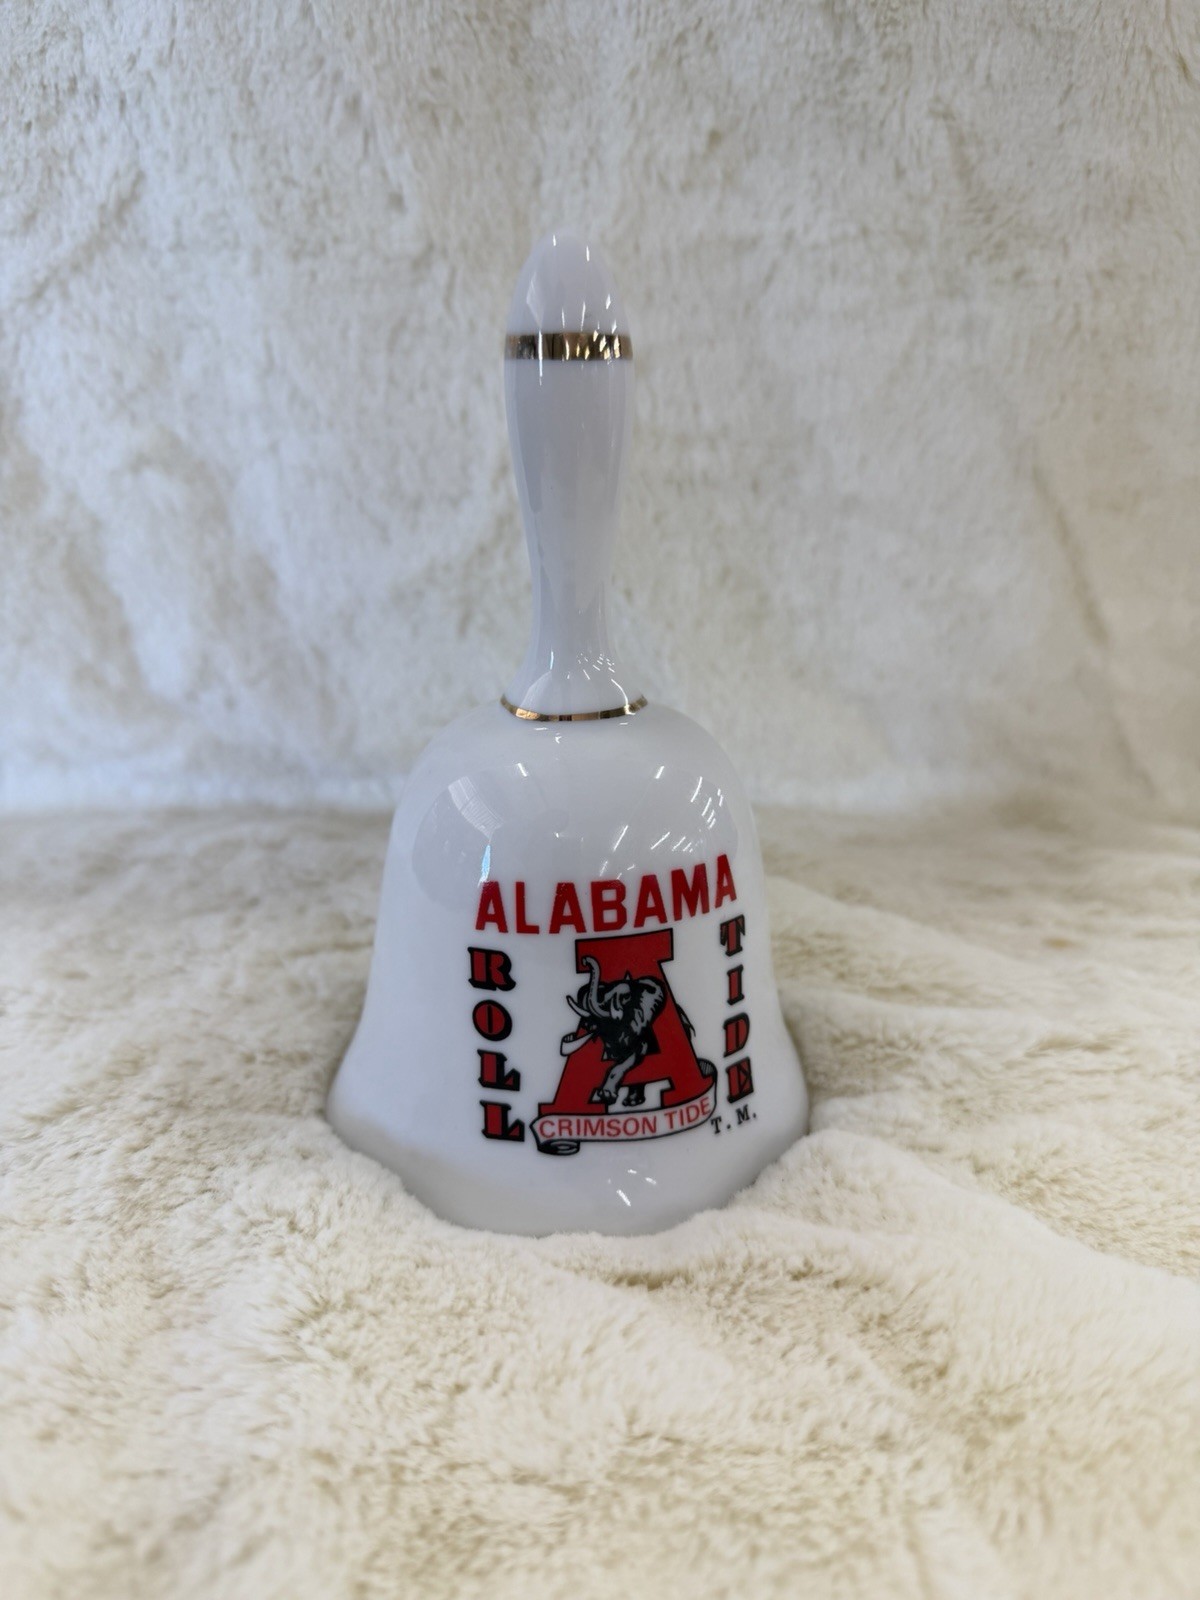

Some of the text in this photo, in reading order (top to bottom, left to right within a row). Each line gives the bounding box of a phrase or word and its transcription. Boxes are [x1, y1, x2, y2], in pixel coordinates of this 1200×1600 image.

[474, 853, 738, 935] ALABAMA
[467, 946, 525, 1143] ROLL
[719, 914, 755, 1104] TIDE
[538, 1096, 712, 1139] CRIMSON TIDE
